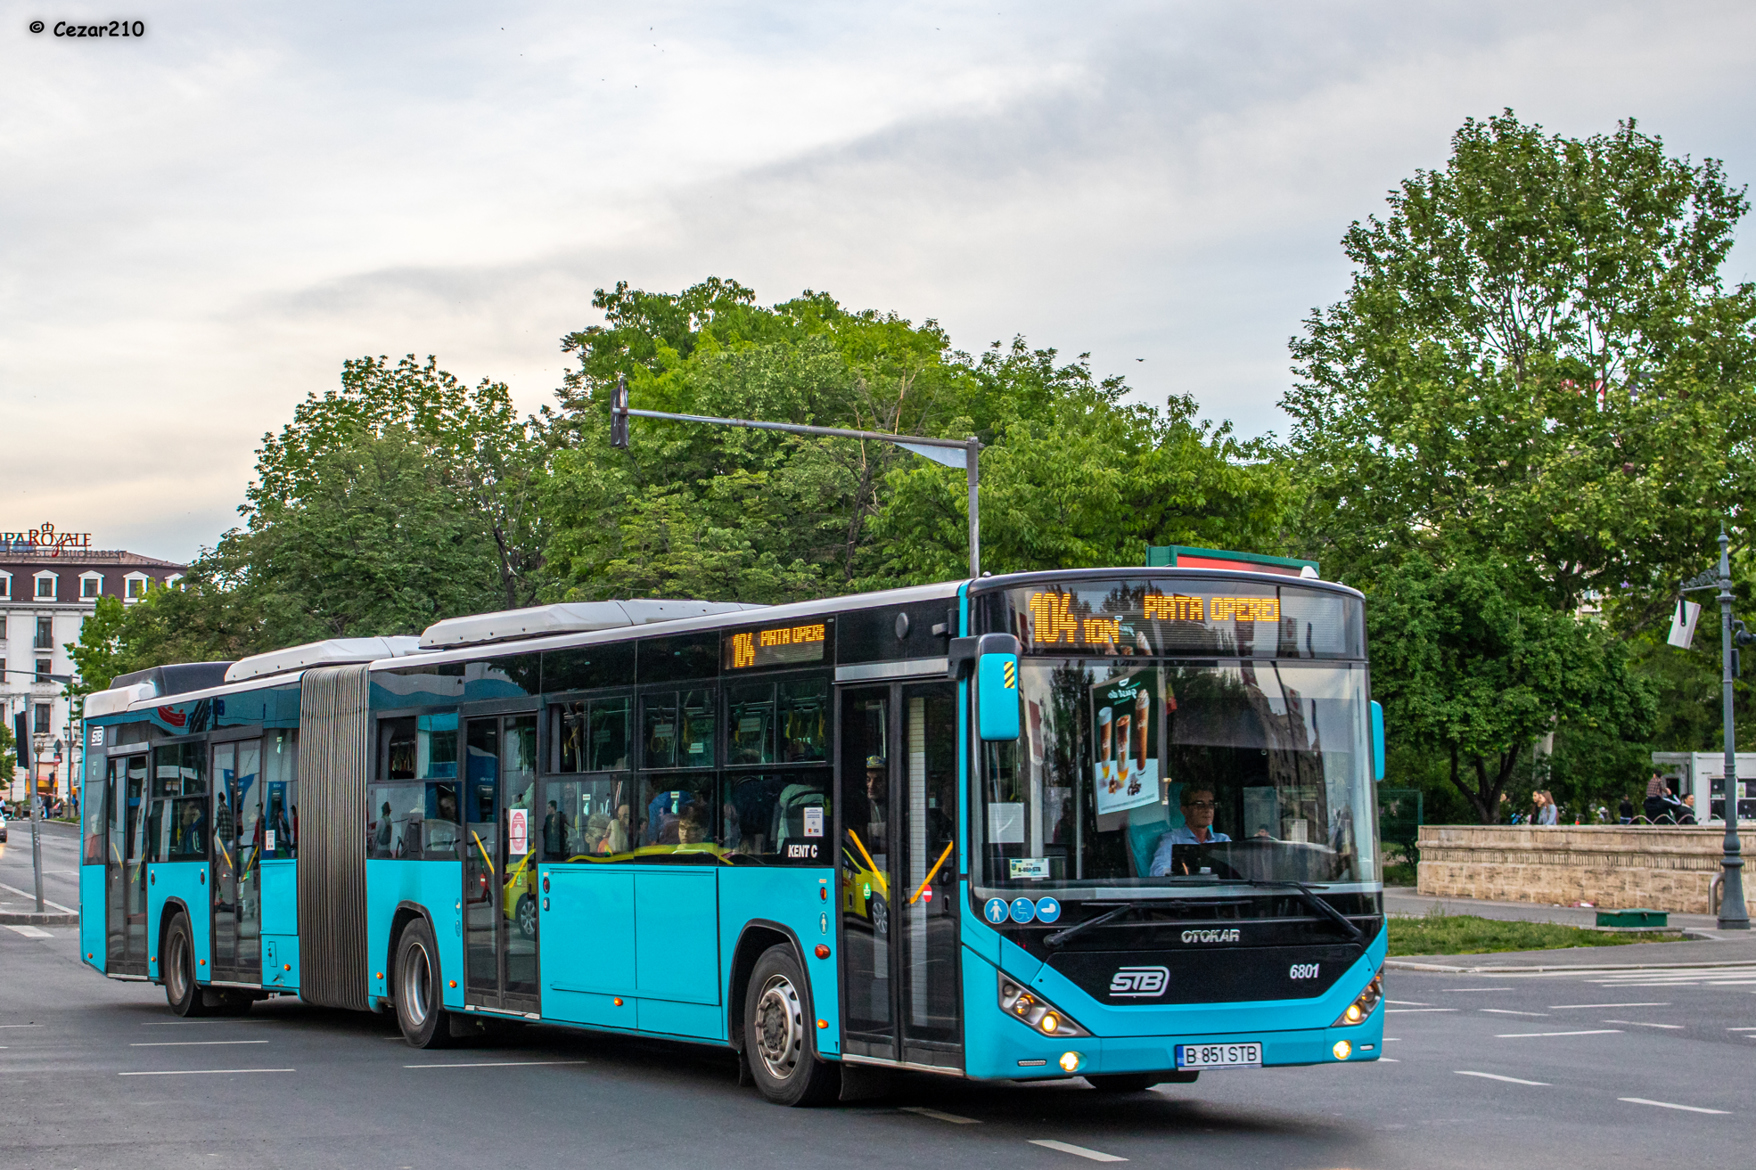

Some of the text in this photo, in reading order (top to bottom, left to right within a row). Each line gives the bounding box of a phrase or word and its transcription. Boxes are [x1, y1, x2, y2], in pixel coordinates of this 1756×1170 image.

[63, 549, 127, 559] BUCHAREST
[1029, 592, 1078, 643] 104
[1143, 595, 1280, 622] PIATA OPEREI
[760, 627, 791, 647] PIATA
[732, 632, 755, 668] 104
[787, 844, 818, 858] KENT C
[1181, 928, 1241, 944] OTOKAR
[1110, 970, 1166, 992] STB
[1289, 963, 1321, 980] 6801
[1185, 1045, 1258, 1064] B 851 STB
